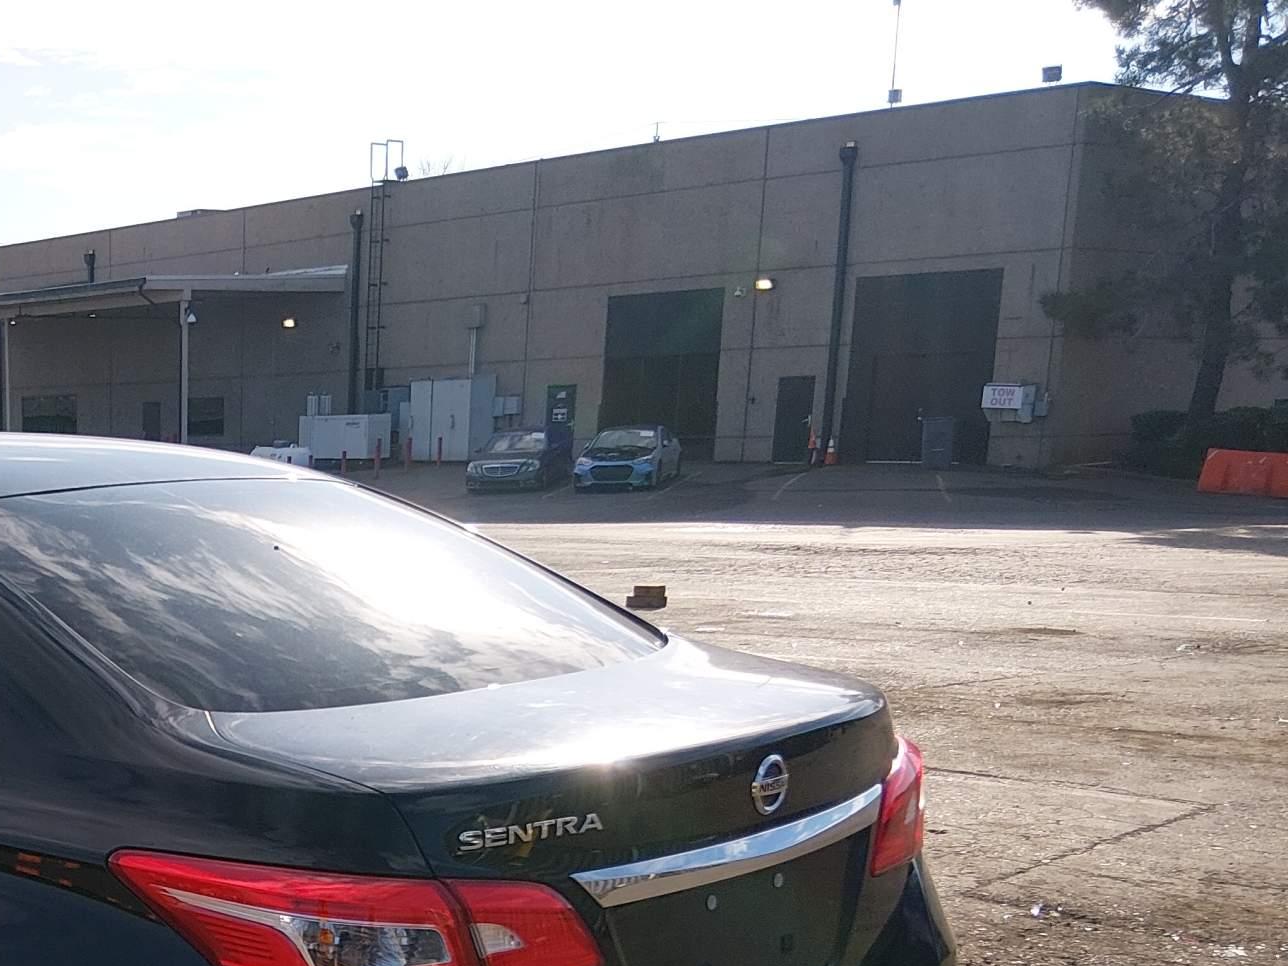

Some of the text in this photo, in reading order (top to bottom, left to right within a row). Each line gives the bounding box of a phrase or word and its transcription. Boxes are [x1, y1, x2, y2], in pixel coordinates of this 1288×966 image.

[991, 388, 1016, 397] TOW
[990, 398, 1014, 406] OUT
[458, 813, 603, 851] SENTRA
